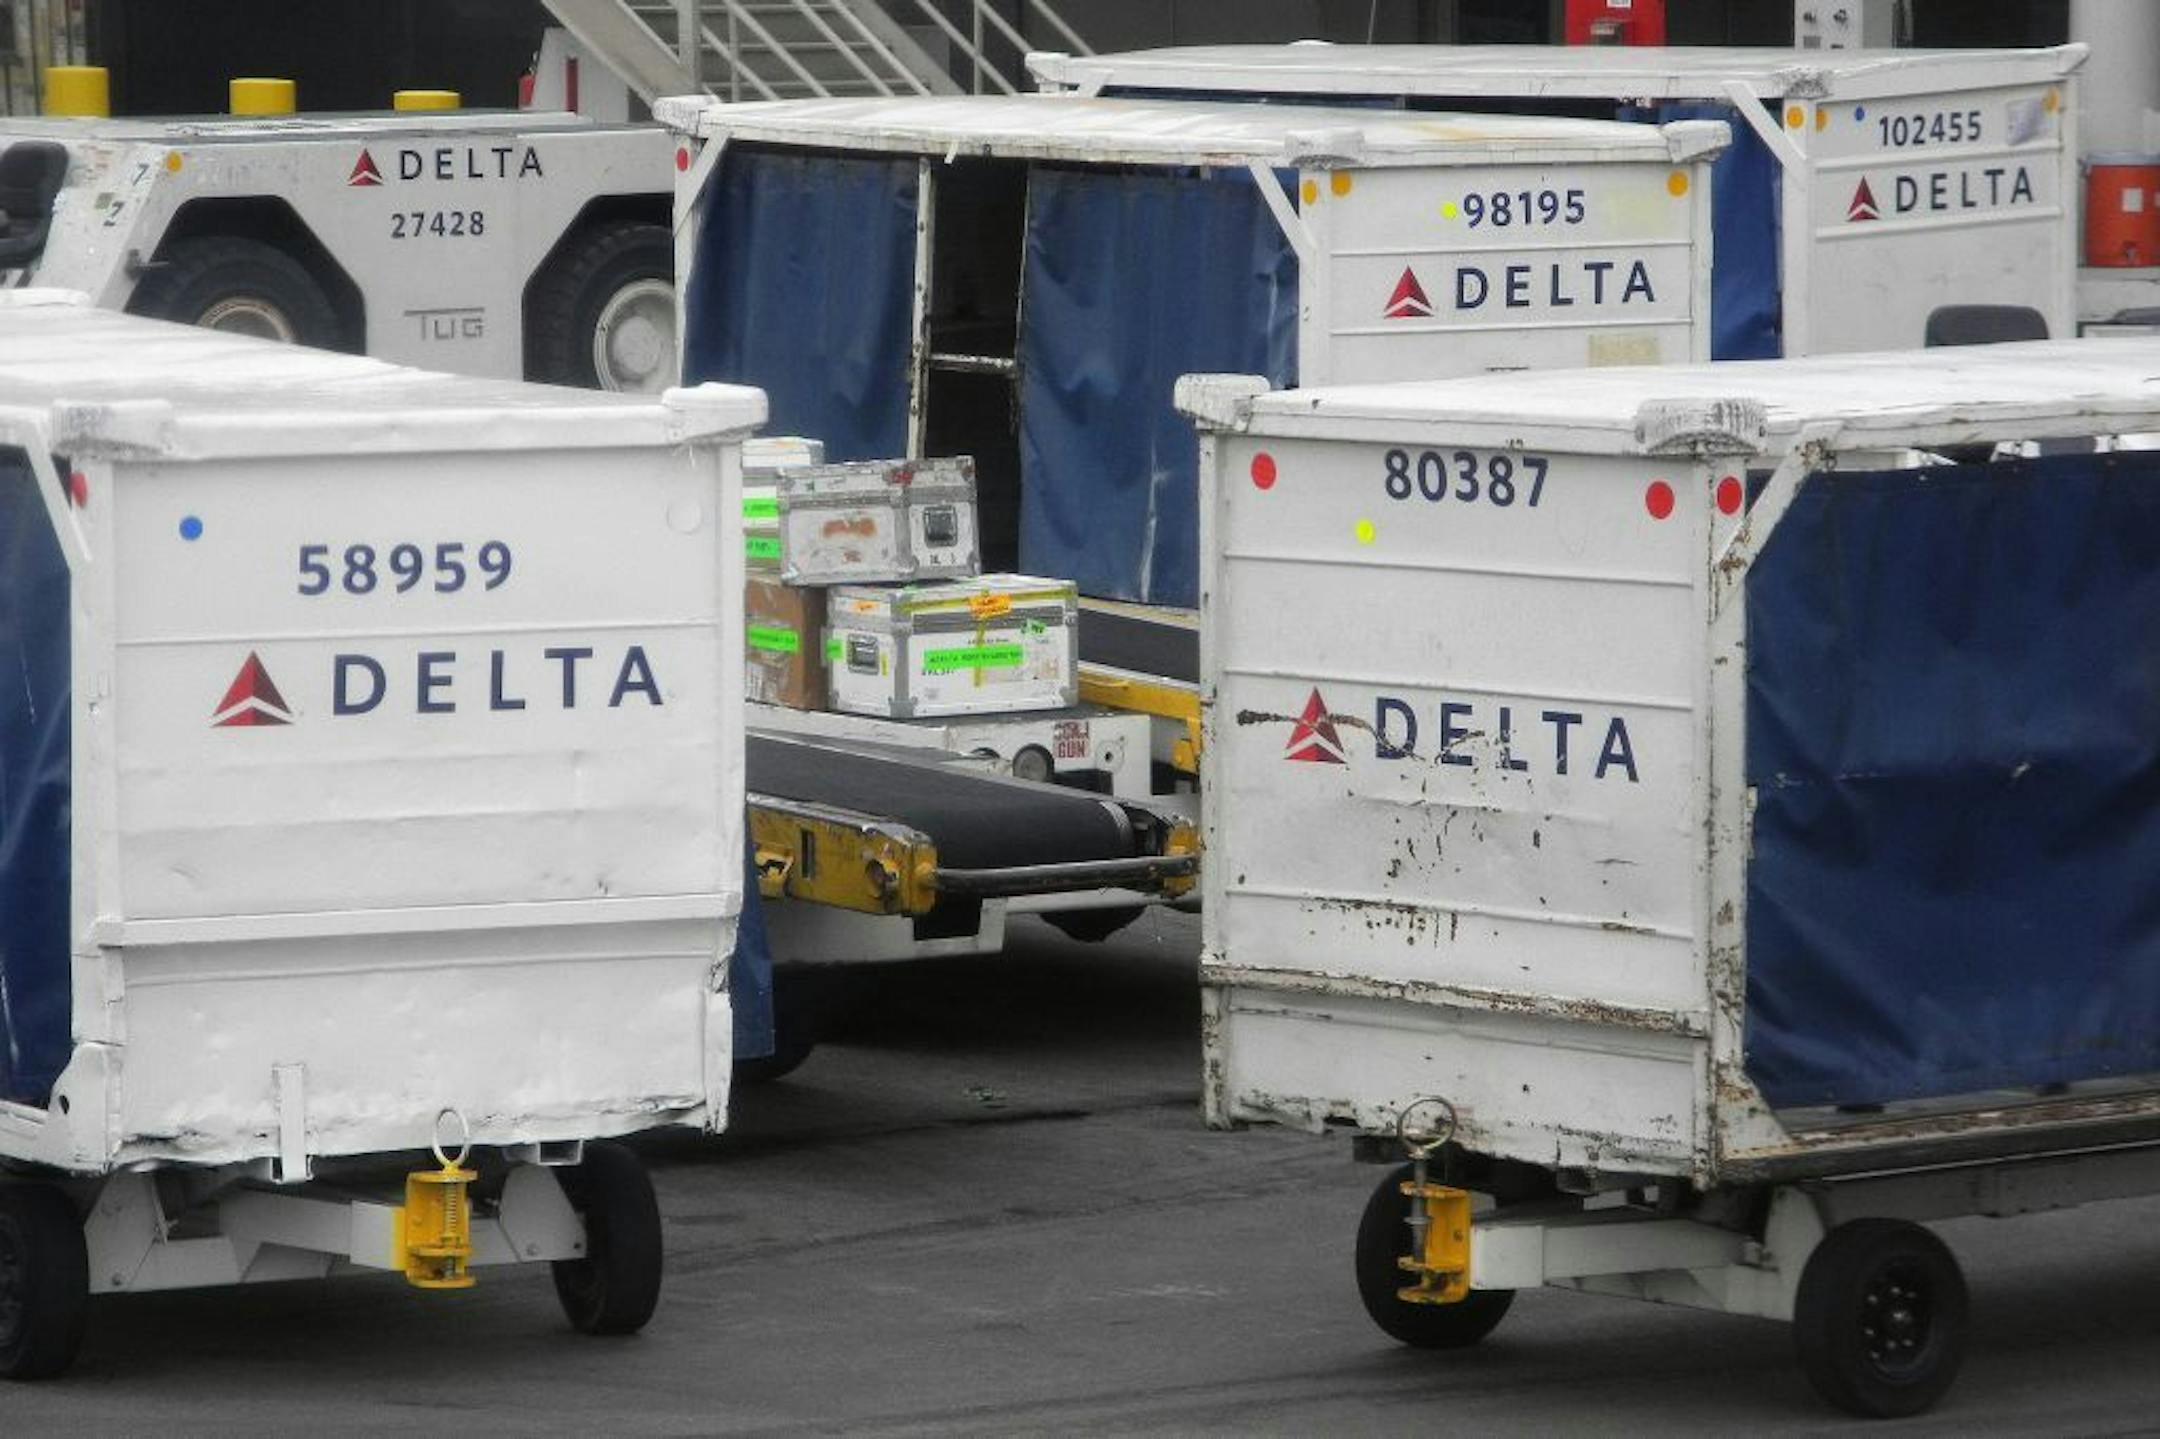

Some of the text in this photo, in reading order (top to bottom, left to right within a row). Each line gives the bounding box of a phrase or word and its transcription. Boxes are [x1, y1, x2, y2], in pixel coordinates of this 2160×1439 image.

[1878, 110, 1982, 147] 102455
[401, 147, 542, 181] DELTA
[1463, 189, 1586, 229] 98195
[1896, 166, 2034, 214] DELTA
[391, 211, 484, 239] 27428
[1456, 260, 1656, 310] DELTA
[1384, 448, 1549, 507] 80387
[298, 541, 512, 596] 58959
[333, 645, 664, 716] DELTA
[1375, 697, 1640, 783] DELTA
